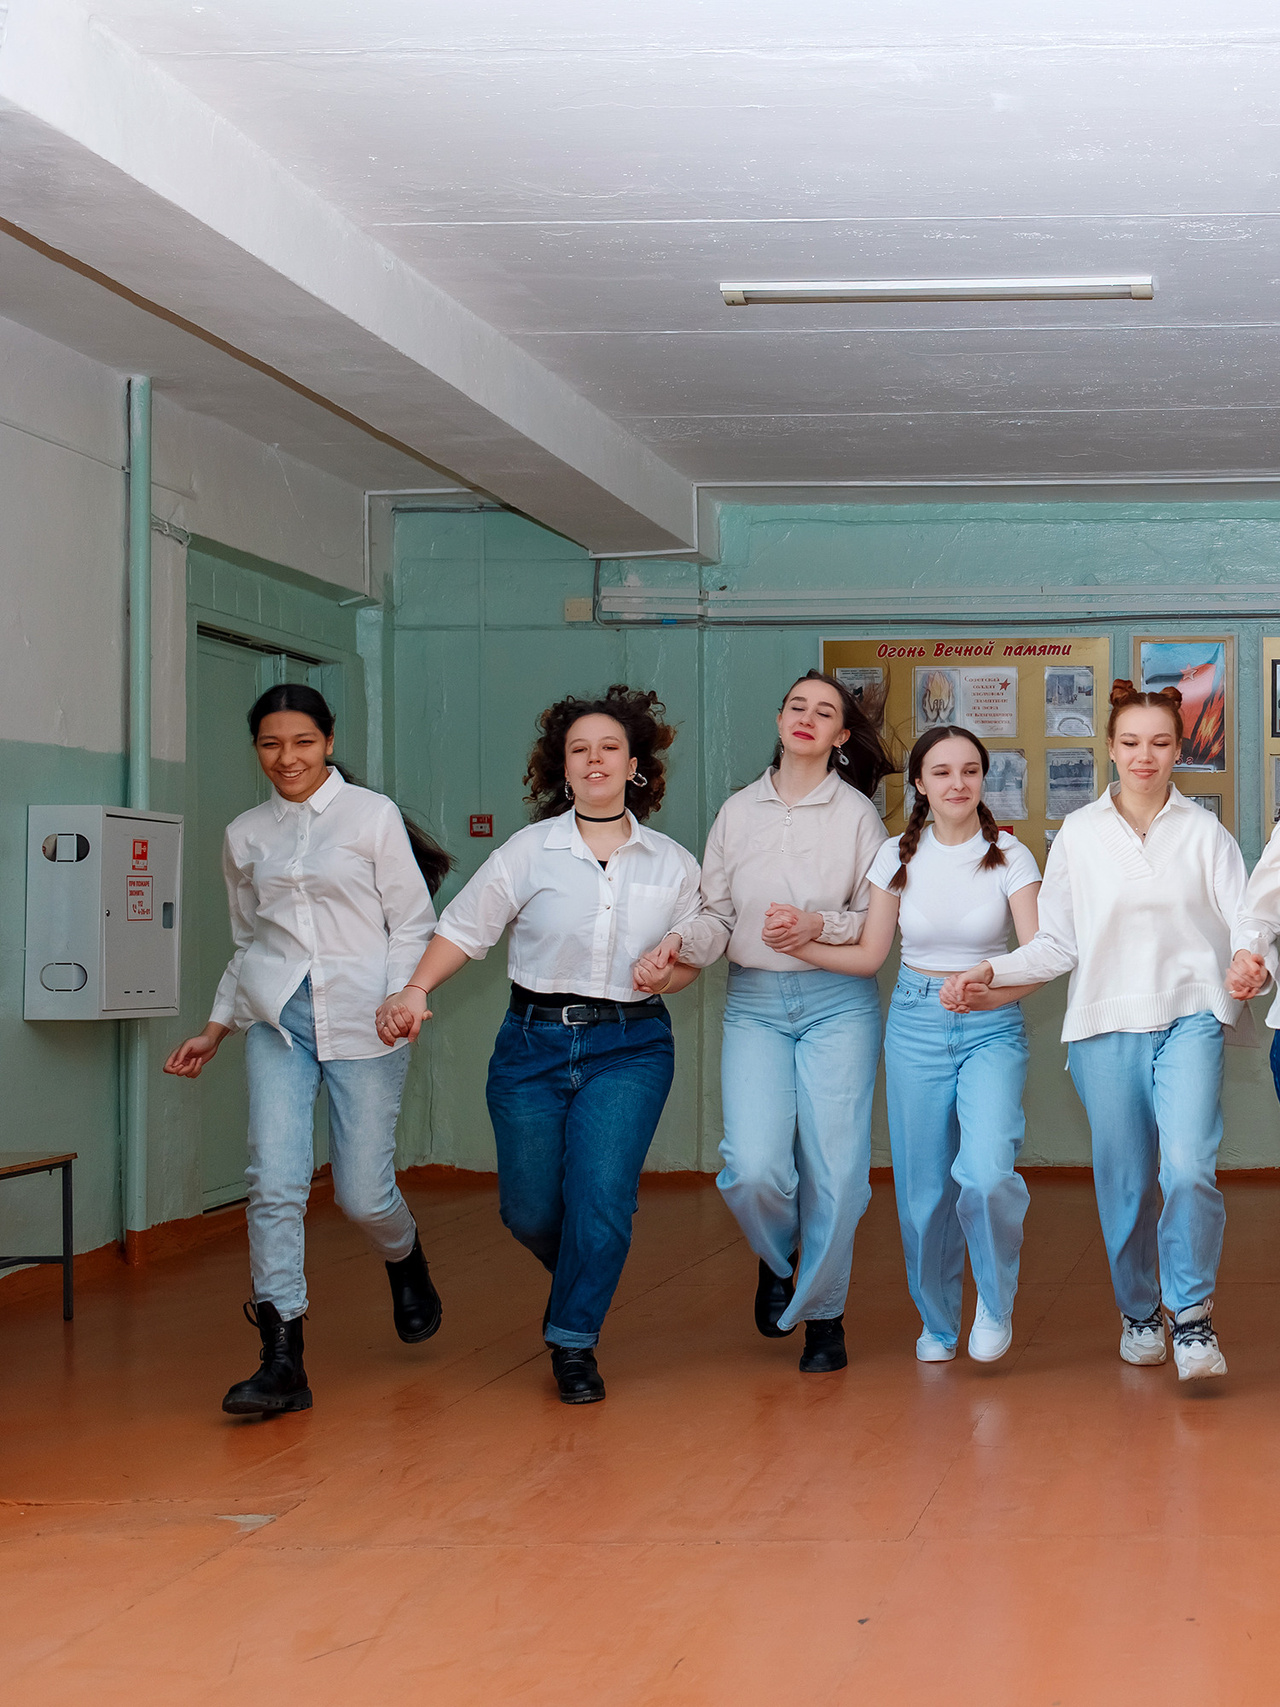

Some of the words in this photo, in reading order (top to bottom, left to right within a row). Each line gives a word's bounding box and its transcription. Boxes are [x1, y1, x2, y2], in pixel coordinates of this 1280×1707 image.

[877, 643, 926, 659] Огонь
[933, 641, 995, 658] Вечной
[1002, 643, 1072, 657] памяти
